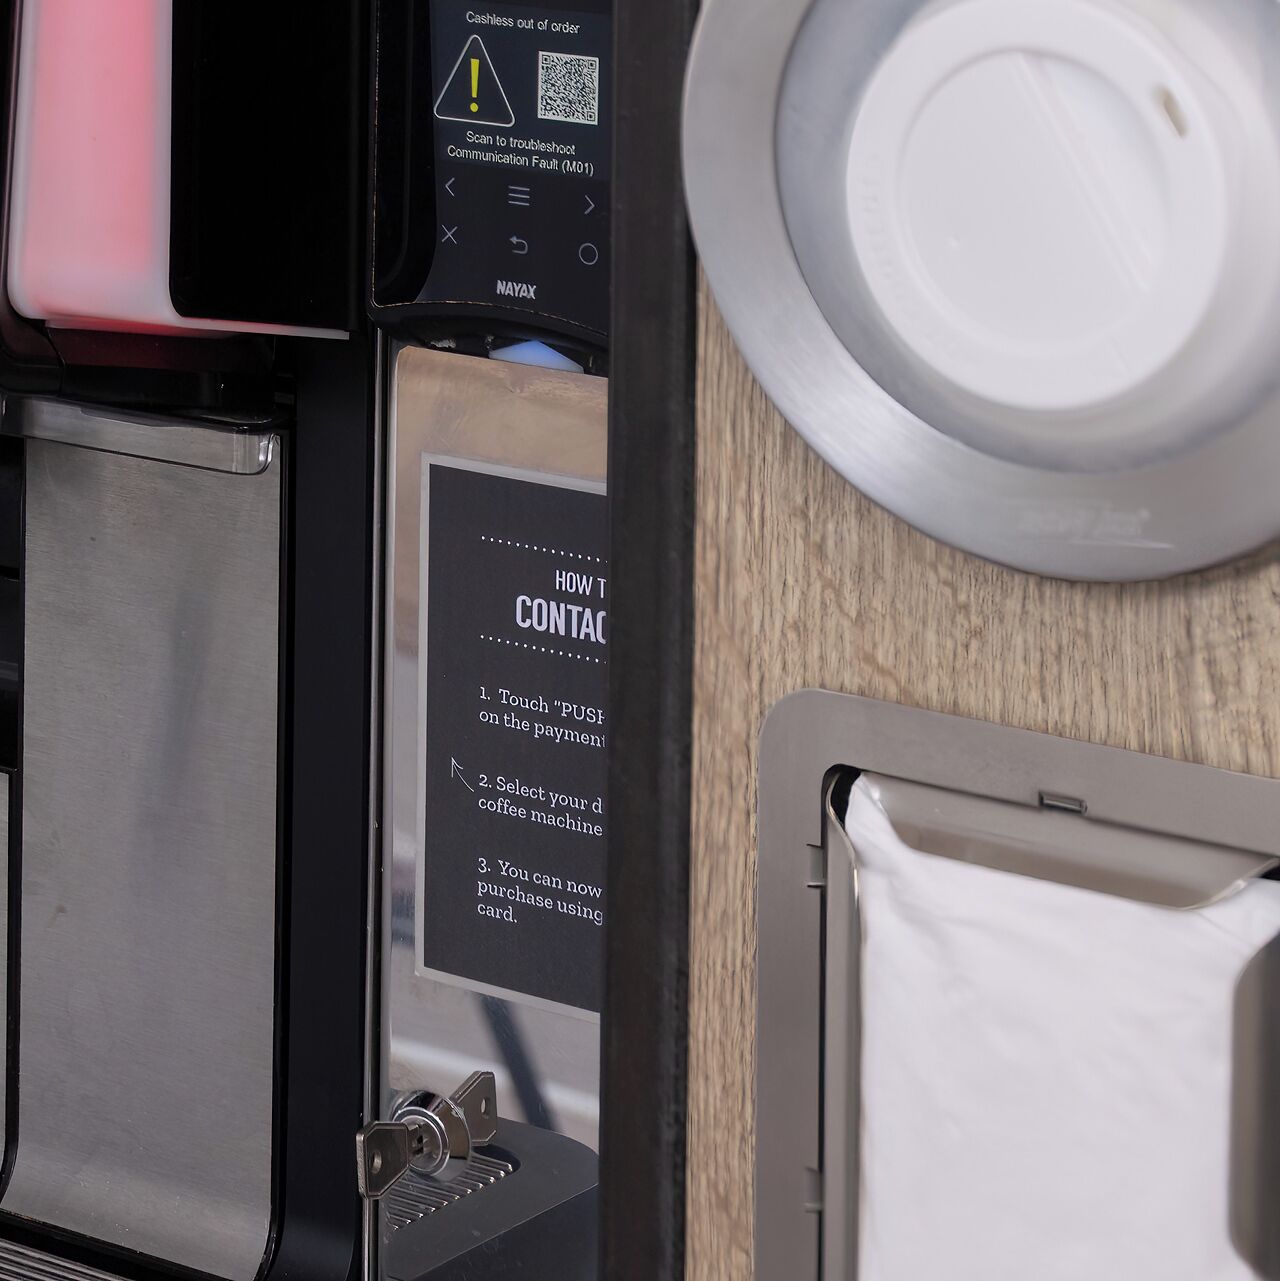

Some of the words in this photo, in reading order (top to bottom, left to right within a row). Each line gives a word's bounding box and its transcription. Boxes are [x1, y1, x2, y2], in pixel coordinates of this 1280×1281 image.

[465, 10, 514, 28] Cashless
[517, 18, 534, 30] out
[537, 19, 549, 31] of
[551, 21, 581, 34] order
[466, 130, 493, 145] Scan
[496, 135, 507, 147] to
[509, 136, 576, 156] troubleshoot
[447, 144, 529, 167] Communication
[531, 155, 559, 171] Fault
[561, 159, 594, 177] (M01)
[496, 279, 537, 300] NAYAX
[555, 569, 593, 596] HOW
[597, 577, 607, 599] T
[515, 594, 607, 645] CONTAC
[479, 686, 491, 700] 1.
[498, 688, 549, 713] Touch
[479, 710, 499, 725] on
[503, 712, 530, 731] the
[478, 774, 492, 788] 2.
[496, 776, 546, 801] Select
[549, 790, 588, 810] your
[478, 797, 527, 818] coffee
[530, 809, 603, 836] machine
[478, 857, 491, 873] 3.
[497, 859, 530, 882] You
[533, 872, 563, 890] can
[566, 880, 603, 899] now
[477, 880, 554, 909] purchase
[556, 900, 603, 926] using
[477, 902, 518, 923] card.
